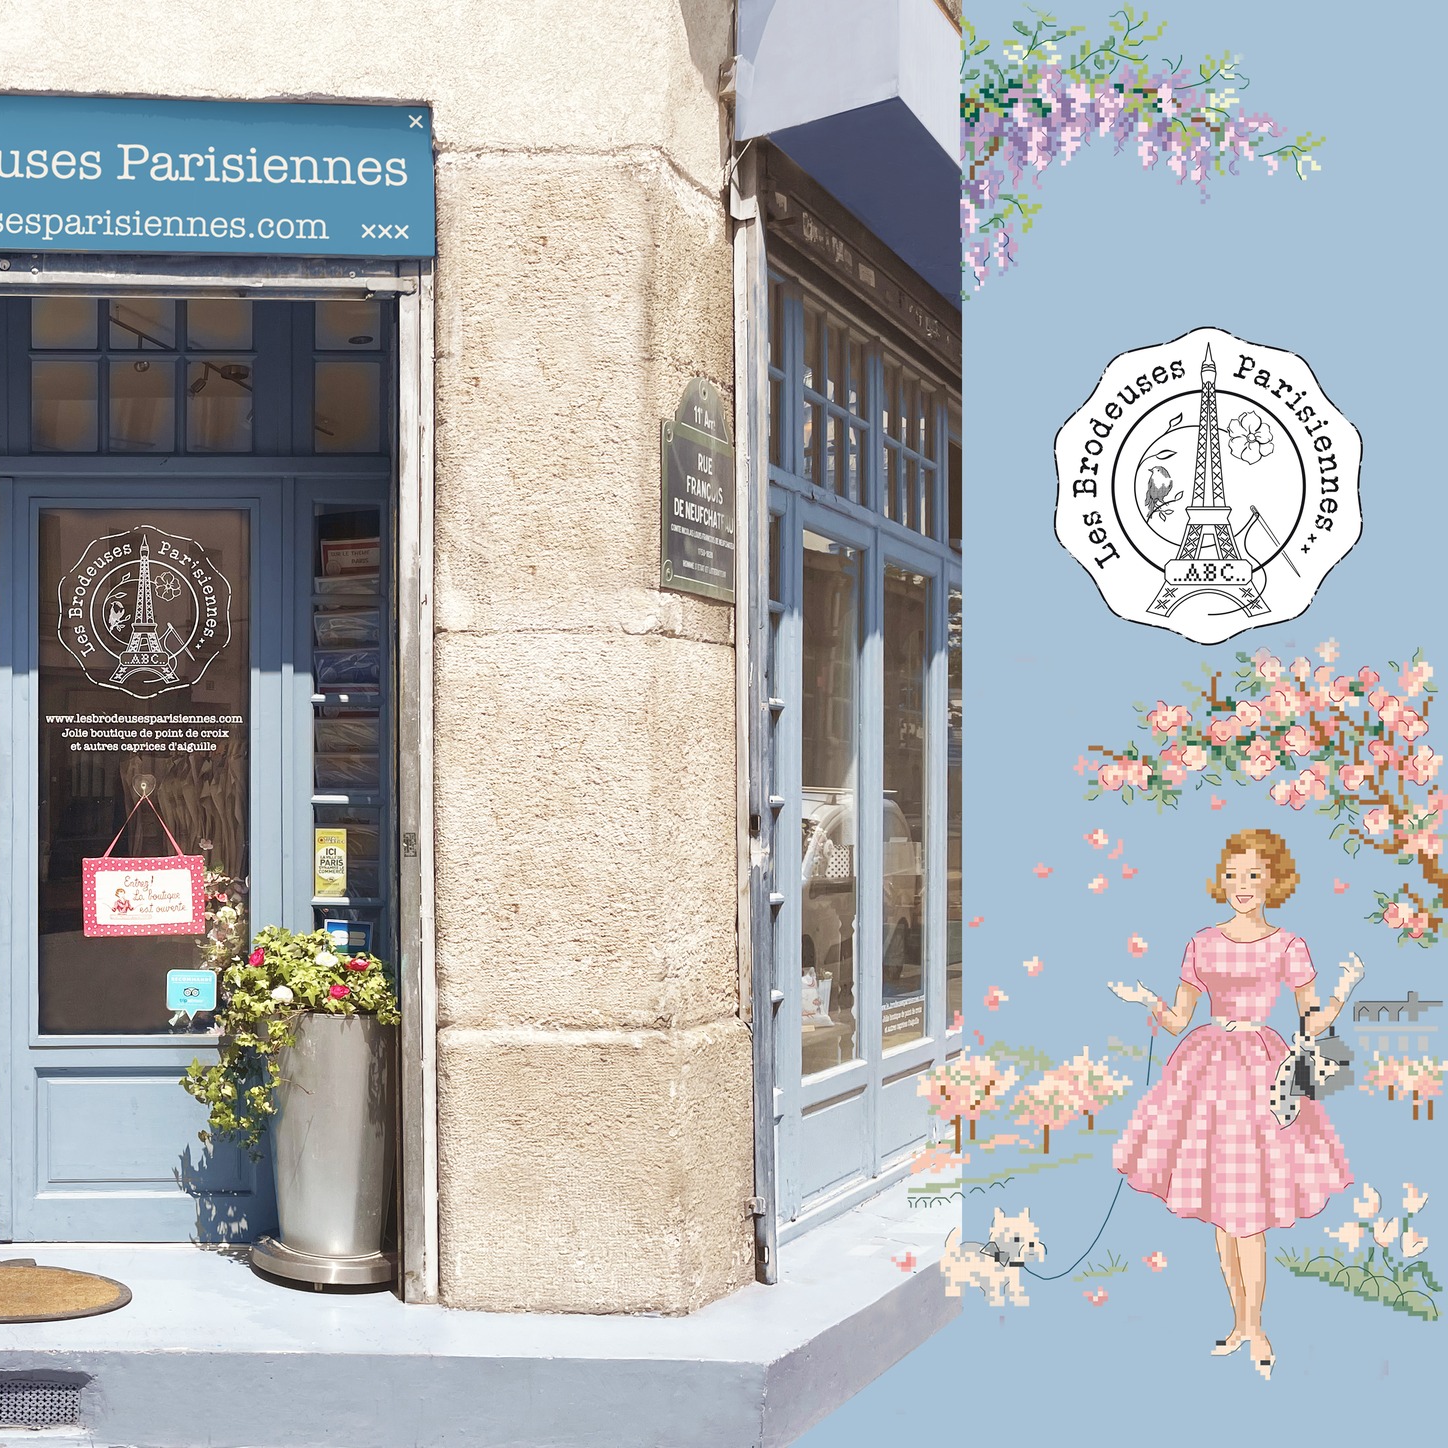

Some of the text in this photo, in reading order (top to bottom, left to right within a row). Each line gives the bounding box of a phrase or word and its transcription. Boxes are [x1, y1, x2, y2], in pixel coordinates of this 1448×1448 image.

[116, 143, 408, 187] Parisiennes
[697, 453, 713, 476] RUE
[673, 497, 685, 518] DE
[68, 541, 219, 657] Les Brodeuses Parisiennes
[45, 713, 243, 725] www.lesbrodeusesparisiennes.com
[61, 728, 230, 740] Jolie boutique de point de croix
[70, 742, 217, 753] et autres caprices d'aiguille
[325, 848, 337, 856] ICI
[319, 859, 344, 867] PARIS
[148, 888, 181, 903] boutique
[139, 902, 186, 913] est ouverte
